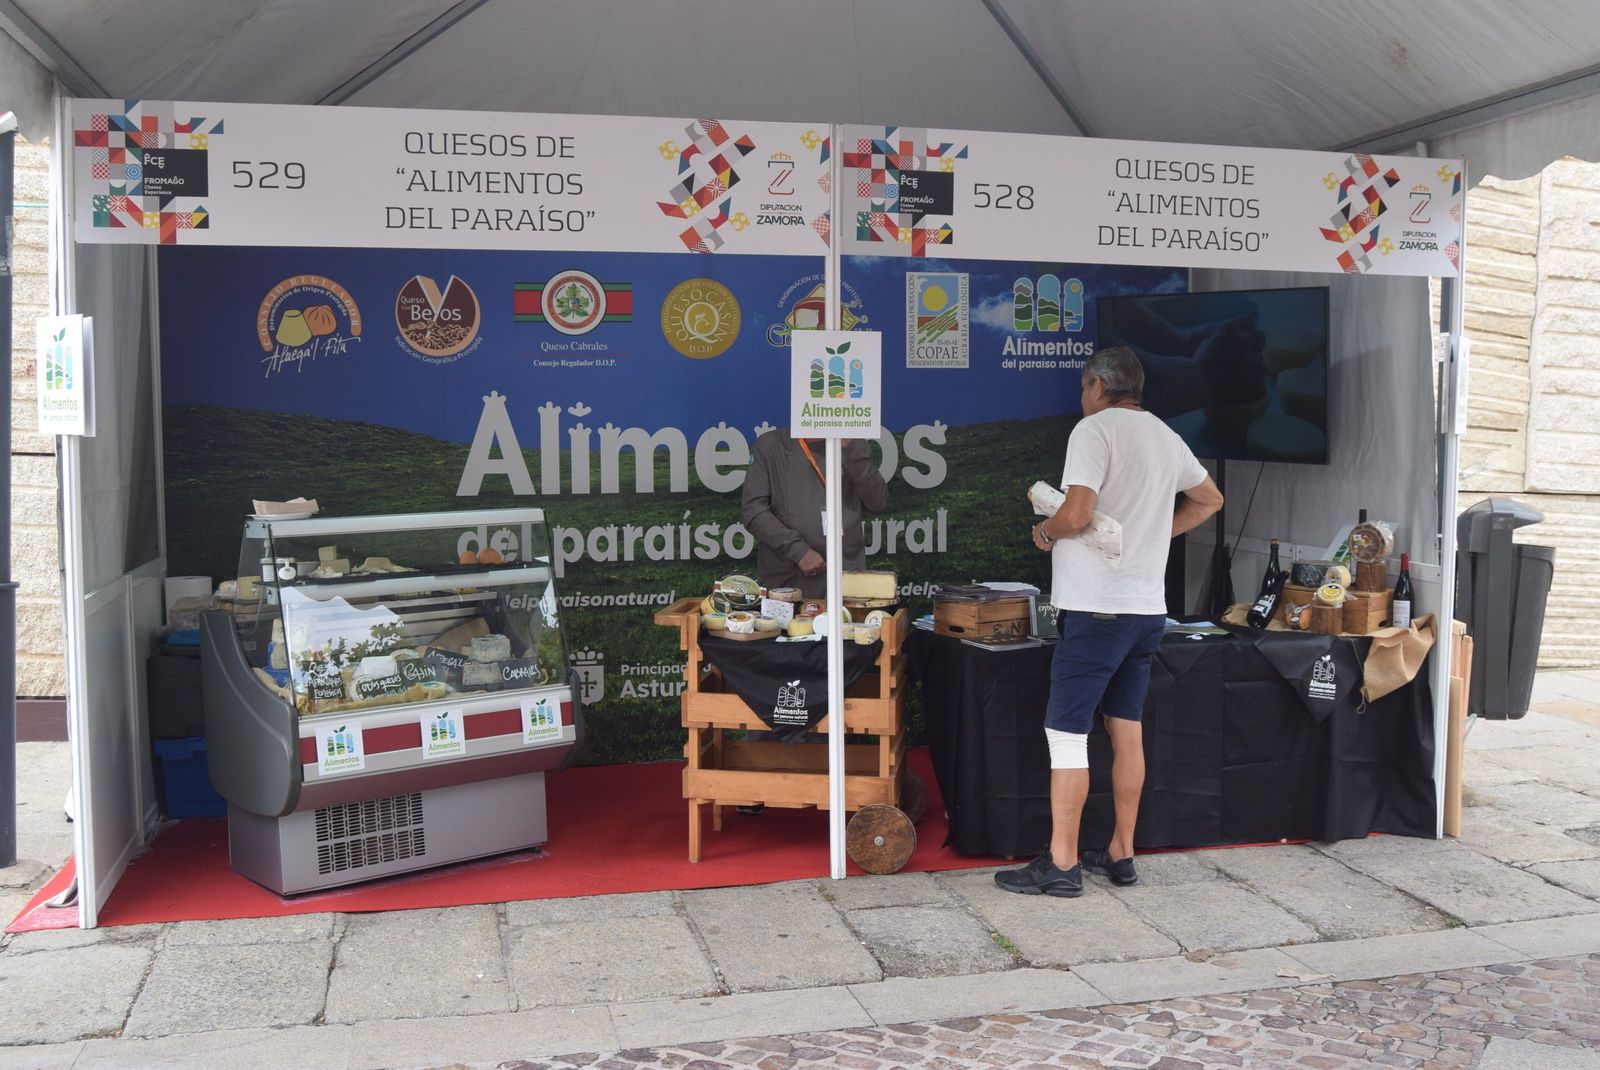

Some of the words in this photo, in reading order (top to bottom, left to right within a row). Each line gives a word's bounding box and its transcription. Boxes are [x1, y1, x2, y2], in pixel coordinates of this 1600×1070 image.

[404, 131, 526, 157] QUESOS
[536, 135, 575, 159] DE
[232, 161, 306, 190] 529
[1114, 157, 1215, 184] QUESOS
[1222, 163, 1255, 185] DE
[395, 166, 584, 196] “ALIMENTOS
[973, 183, 1035, 210] 528
[1107, 189, 1261, 219] “ALIMENTOS
[384, 206, 443, 230] DEL
[450, 204, 596, 232] PARAÍSO”
[756, 214, 806, 226] ZAMORA
[1097, 225, 1146, 248] DEL
[1151, 226, 1270, 252] PARAÍSO”
[1399, 240, 1439, 251] ZAMORA
[400, 296, 425, 304] Queso
[541, 341, 569, 352] Queso
[570, 341, 608, 351] Cabrales
[916, 346, 959, 359] COPAE
[1002, 335, 1094, 356] Alimentos
[533, 359, 560, 368] Consejo
[560, 359, 593, 368] Regulador
[595, 359, 617, 367] D.O.P.
[1002, 358, 1016, 368] del
[42, 396, 78, 411] Alimentos
[800, 401, 872, 417] Alimentos
[800, 419, 812, 427] del
[844, 419, 872, 427] natural
[457, 523, 533, 564] del
[552, 510, 755, 578] paraíso
[620, 680, 687, 699] Astur
[1309, 679, 1337, 690] Alimentos
[773, 706, 808, 716] Alimentos
[428, 741, 461, 751] Alimentos
[324, 756, 360, 767] Alimentos
